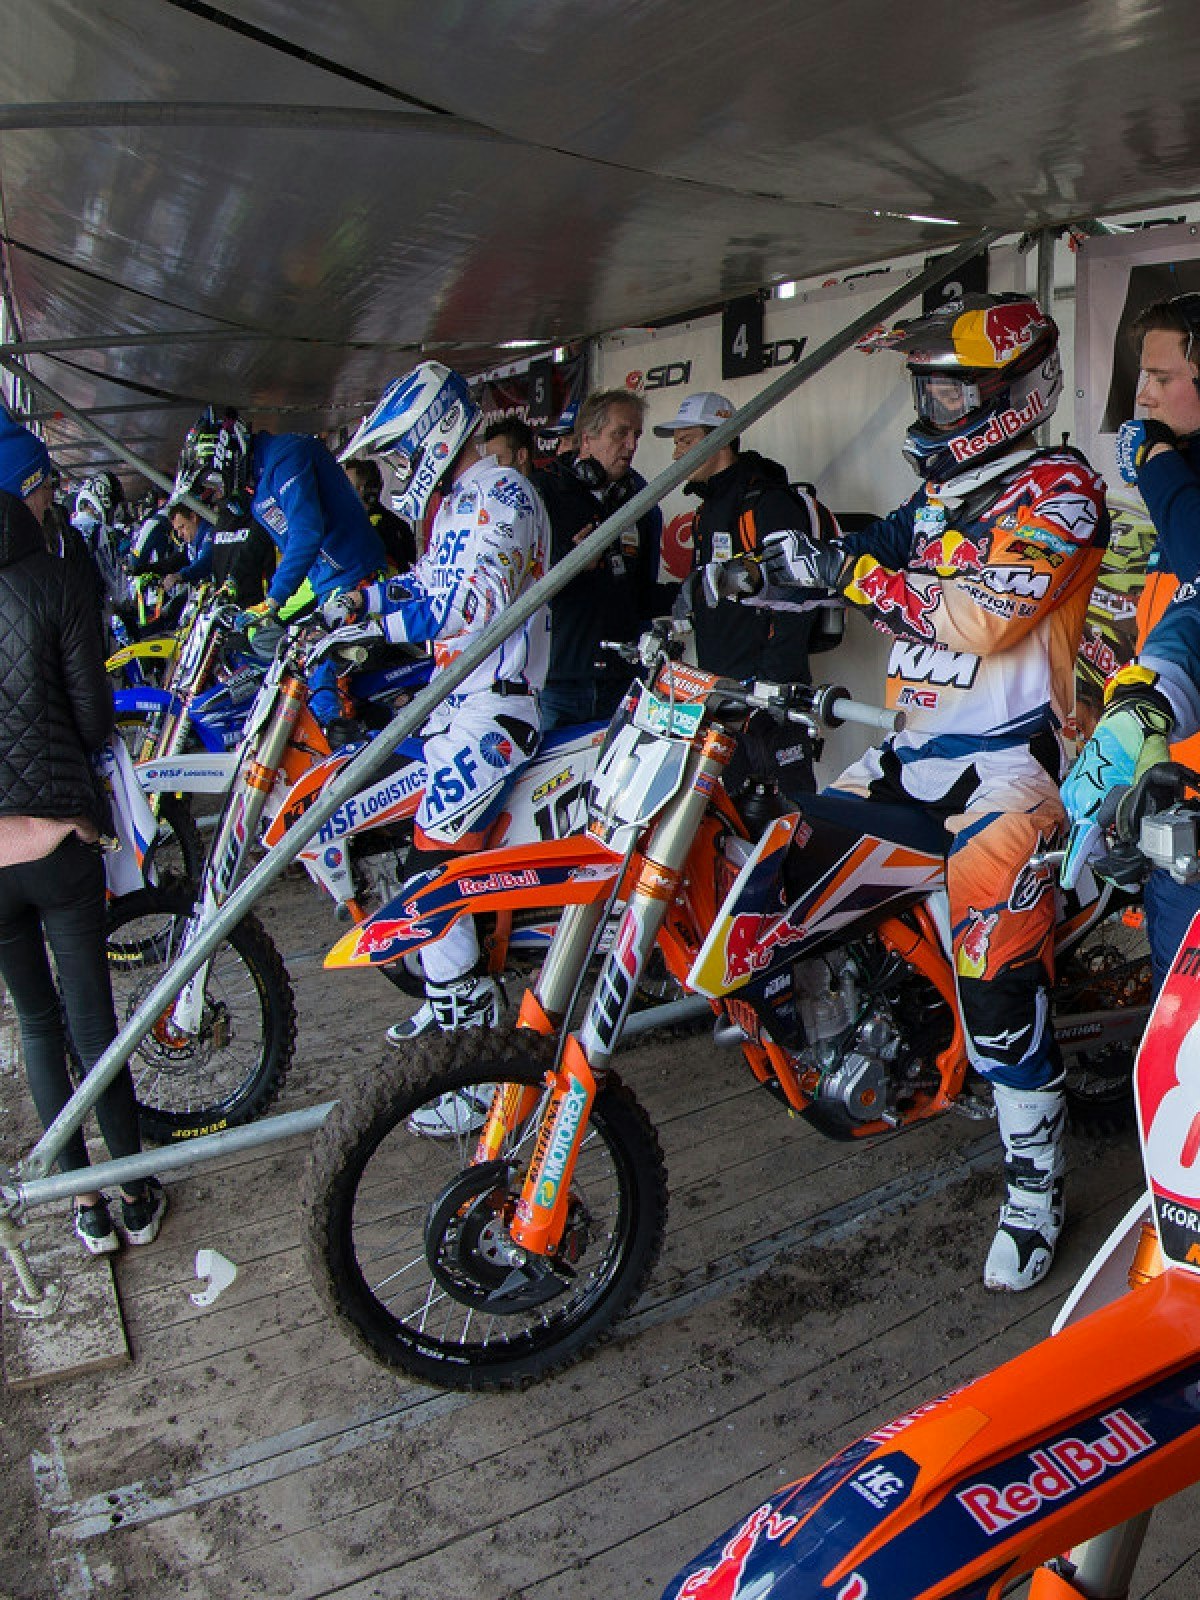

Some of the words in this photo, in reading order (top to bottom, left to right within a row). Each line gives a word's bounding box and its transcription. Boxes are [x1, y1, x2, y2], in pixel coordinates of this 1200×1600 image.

[732, 323, 749, 359] 4
[535, 377, 546, 404] 5
[948, 414, 1006, 464] Red
[1000, 389, 1044, 440] Bull
[887, 640, 982, 690] KTM
[319, 799, 357, 844] HSF
[360, 767, 429, 819] LOGISTICS
[459, 875, 500, 897] Red
[499, 868, 540, 892] Bull
[543, 1087, 586, 1182] MOTOREX
[956, 1451, 1076, 1538] Red
[1057, 1408, 1156, 1492] Bull
